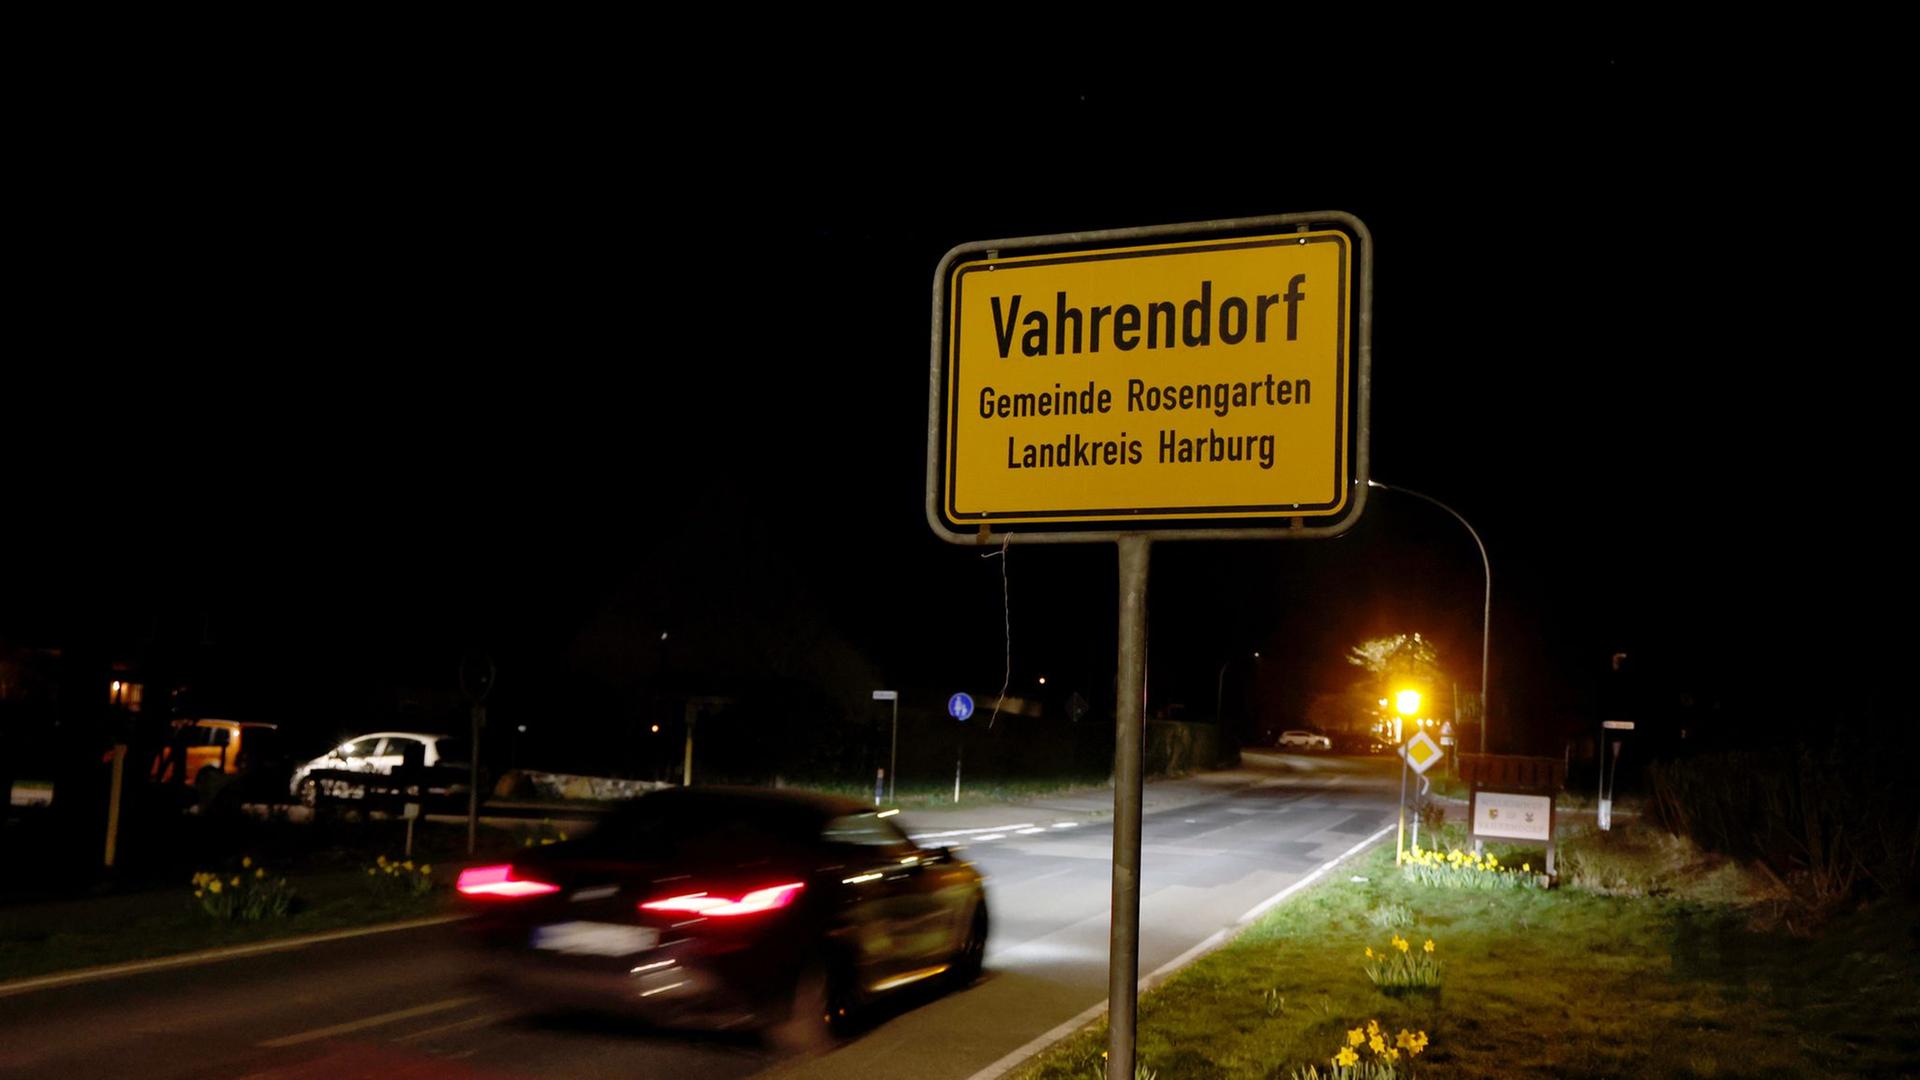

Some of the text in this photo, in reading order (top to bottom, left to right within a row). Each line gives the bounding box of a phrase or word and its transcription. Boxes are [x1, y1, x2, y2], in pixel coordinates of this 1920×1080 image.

[991, 274, 1305, 358] Vahrendorf
[979, 374, 1310, 419] Gemeinde Rosengarten
[1008, 429, 1275, 469] Landkreis Harburg
